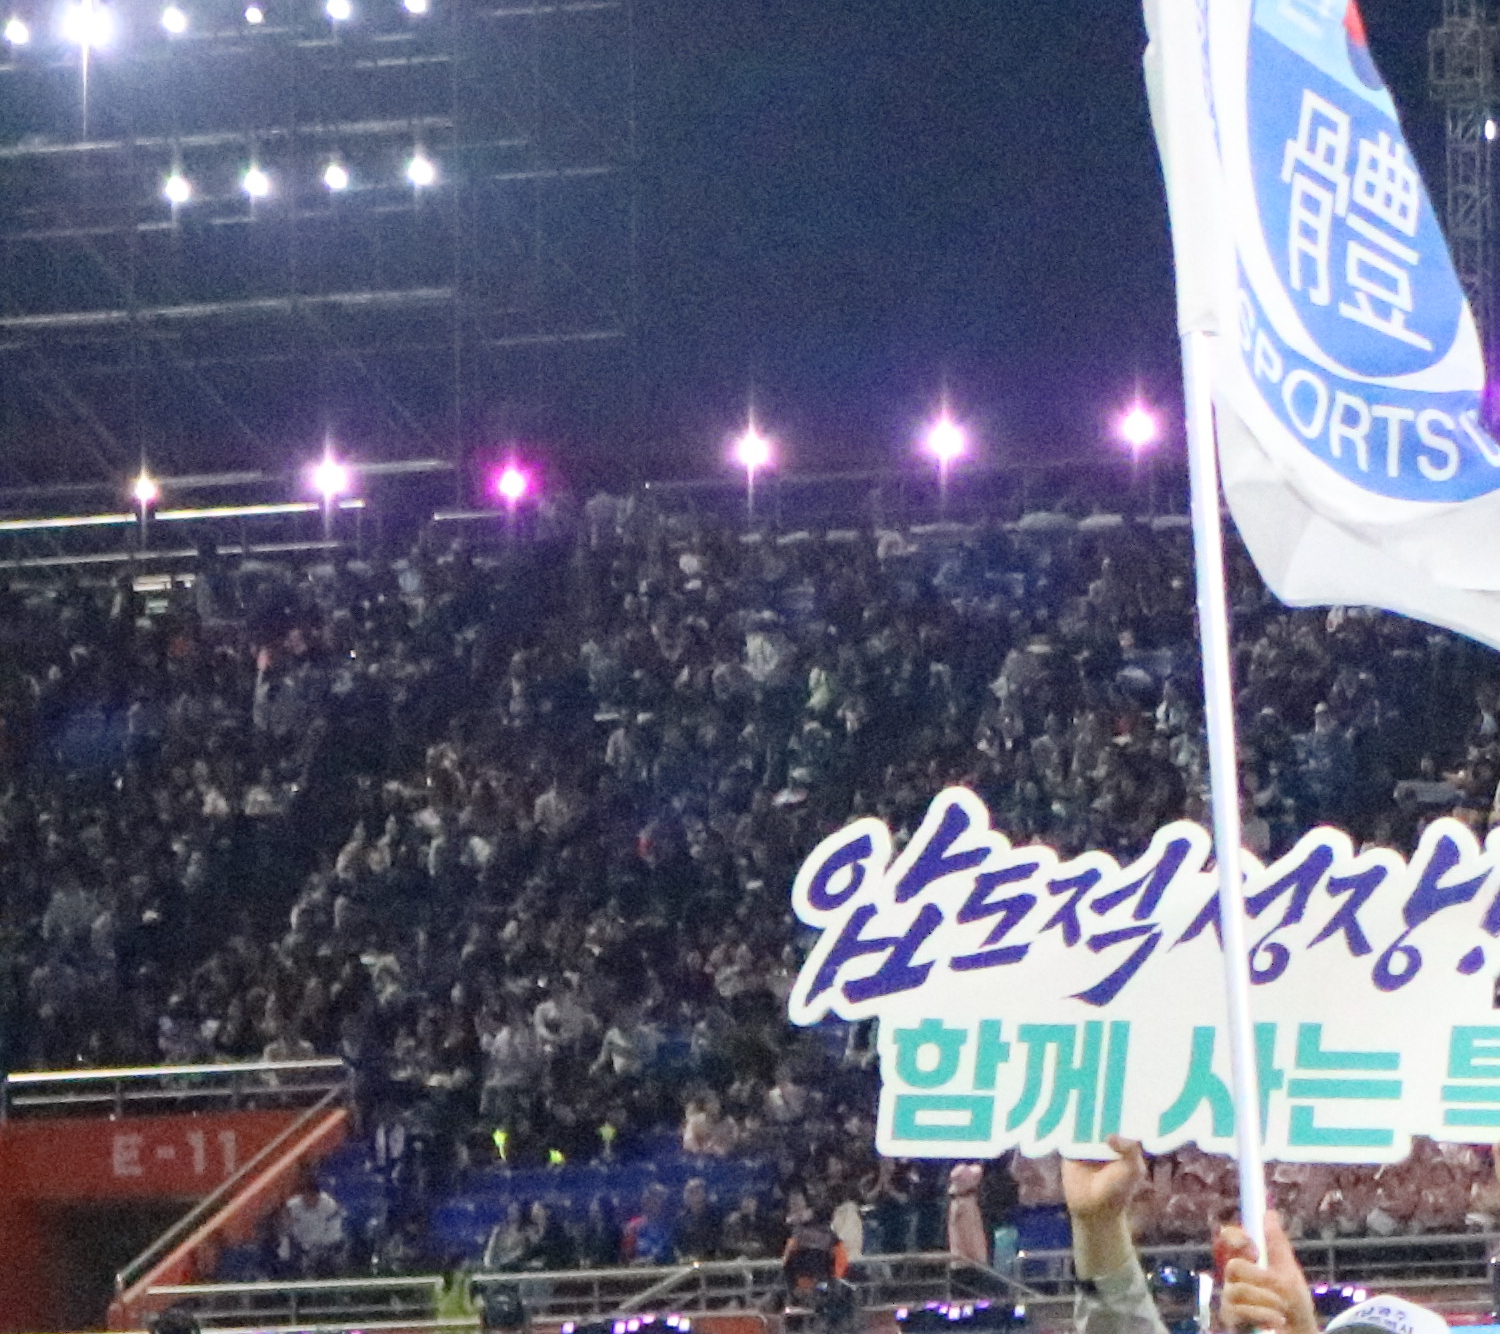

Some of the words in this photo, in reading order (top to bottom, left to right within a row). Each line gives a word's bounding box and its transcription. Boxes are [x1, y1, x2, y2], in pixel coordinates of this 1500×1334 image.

[1239, 288, 1460, 482] SPORTS
[893, 1018, 1130, 1144] 함께
[1159, 1023, 1402, 1148] 사는
[113, 1130, 237, 1176] E-11
